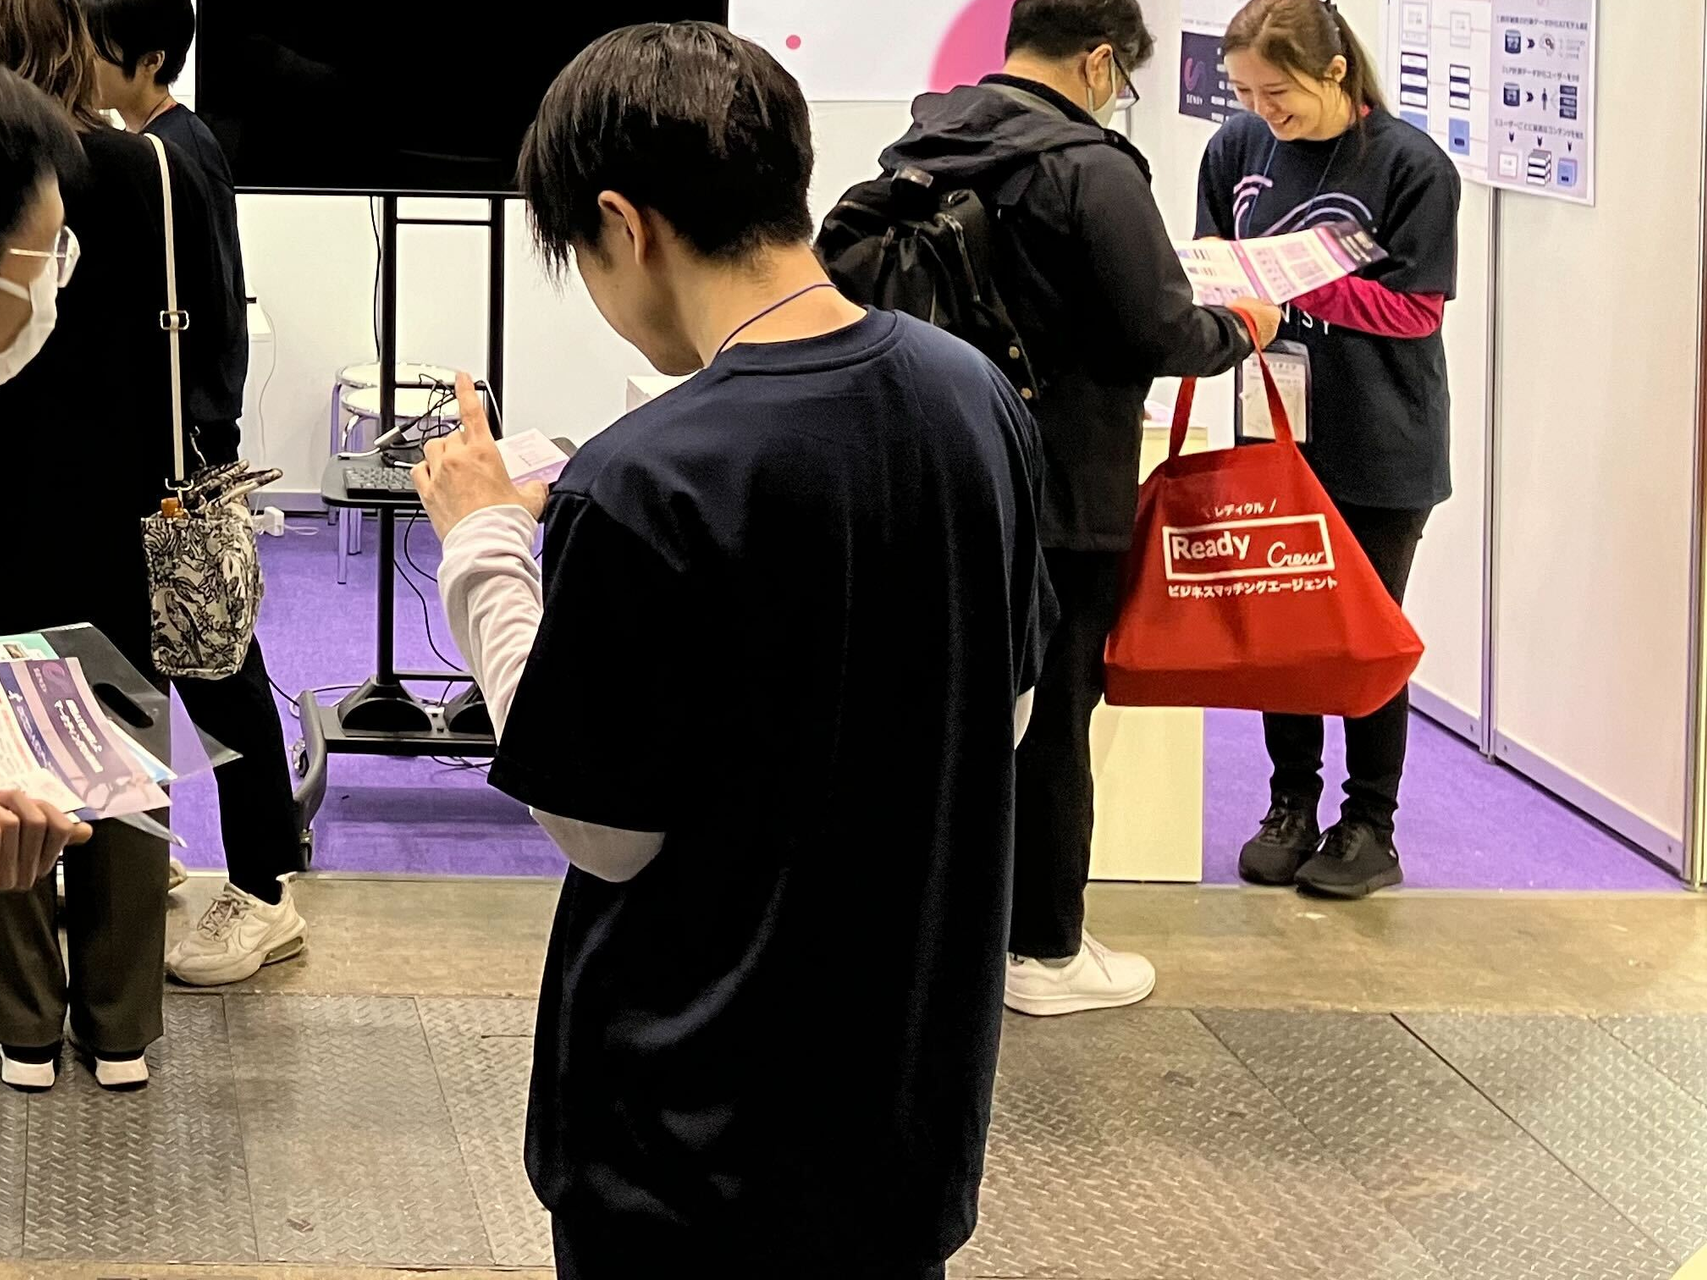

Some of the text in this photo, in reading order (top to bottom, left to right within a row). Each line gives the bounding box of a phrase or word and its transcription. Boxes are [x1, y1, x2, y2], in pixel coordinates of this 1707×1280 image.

[1214, 502, 1265, 518] レディクル
[1171, 531, 1325, 568] Ready Crew
[1168, 576, 1338, 599] ビジネスマッチングエージェント
